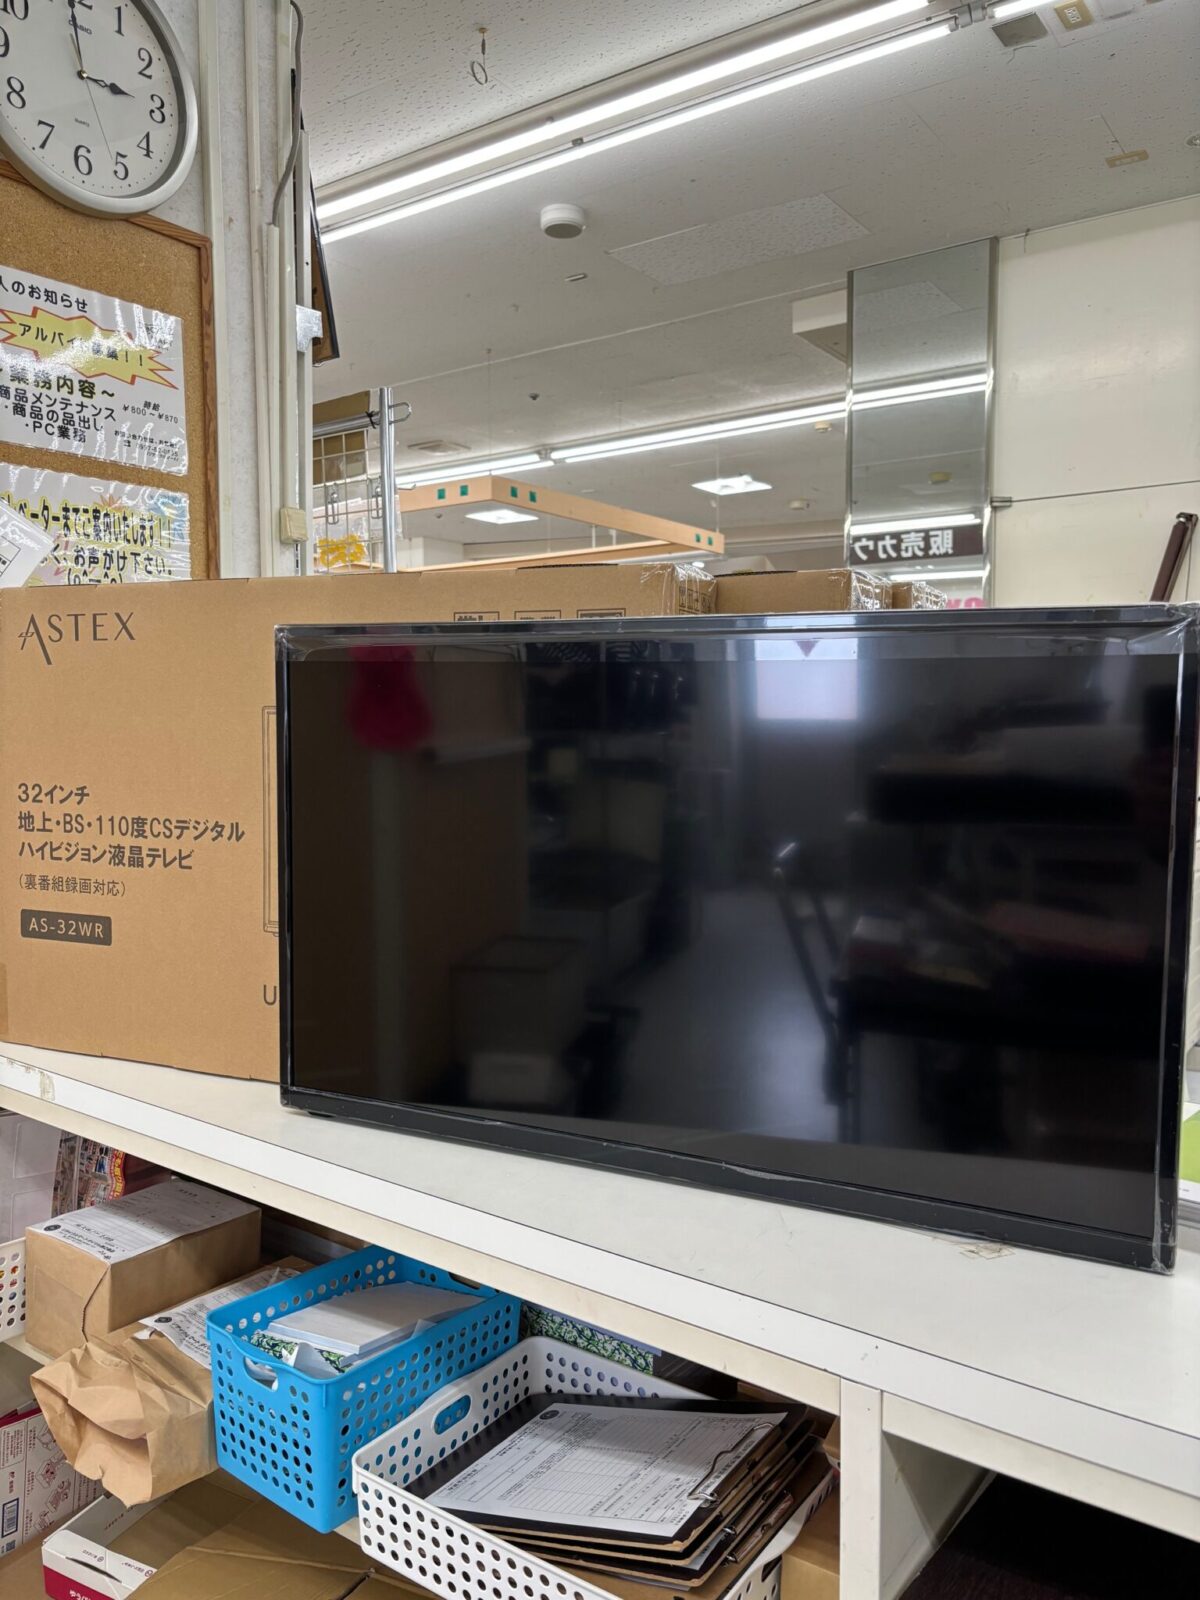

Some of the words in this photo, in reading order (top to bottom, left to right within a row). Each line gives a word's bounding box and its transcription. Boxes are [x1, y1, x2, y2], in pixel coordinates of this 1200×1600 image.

[115, 6, 124, 37] 1
[138, 48, 153, 80] 2
[6, 76, 26, 109] 8
[149, 94, 166, 124] 3
[37, 120, 55, 149] 7
[136, 131, 154, 159] 4
[73, 144, 93, 176] 6
[113, 152, 129, 180] 5
[40, 543, 174, 576] く、お声がけ下さい。
[18, 612, 136, 665] ASTEX
[17, 782, 90, 805] 32インチ
[18, 810, 245, 843] 地上・BS・110度CSデジタル
[18, 841, 193, 870] ハイビジョン液晶テレビ
[18, 872, 127, 898] (裏番組録画対応)
[28, 917, 105, 938] AS-32WR
